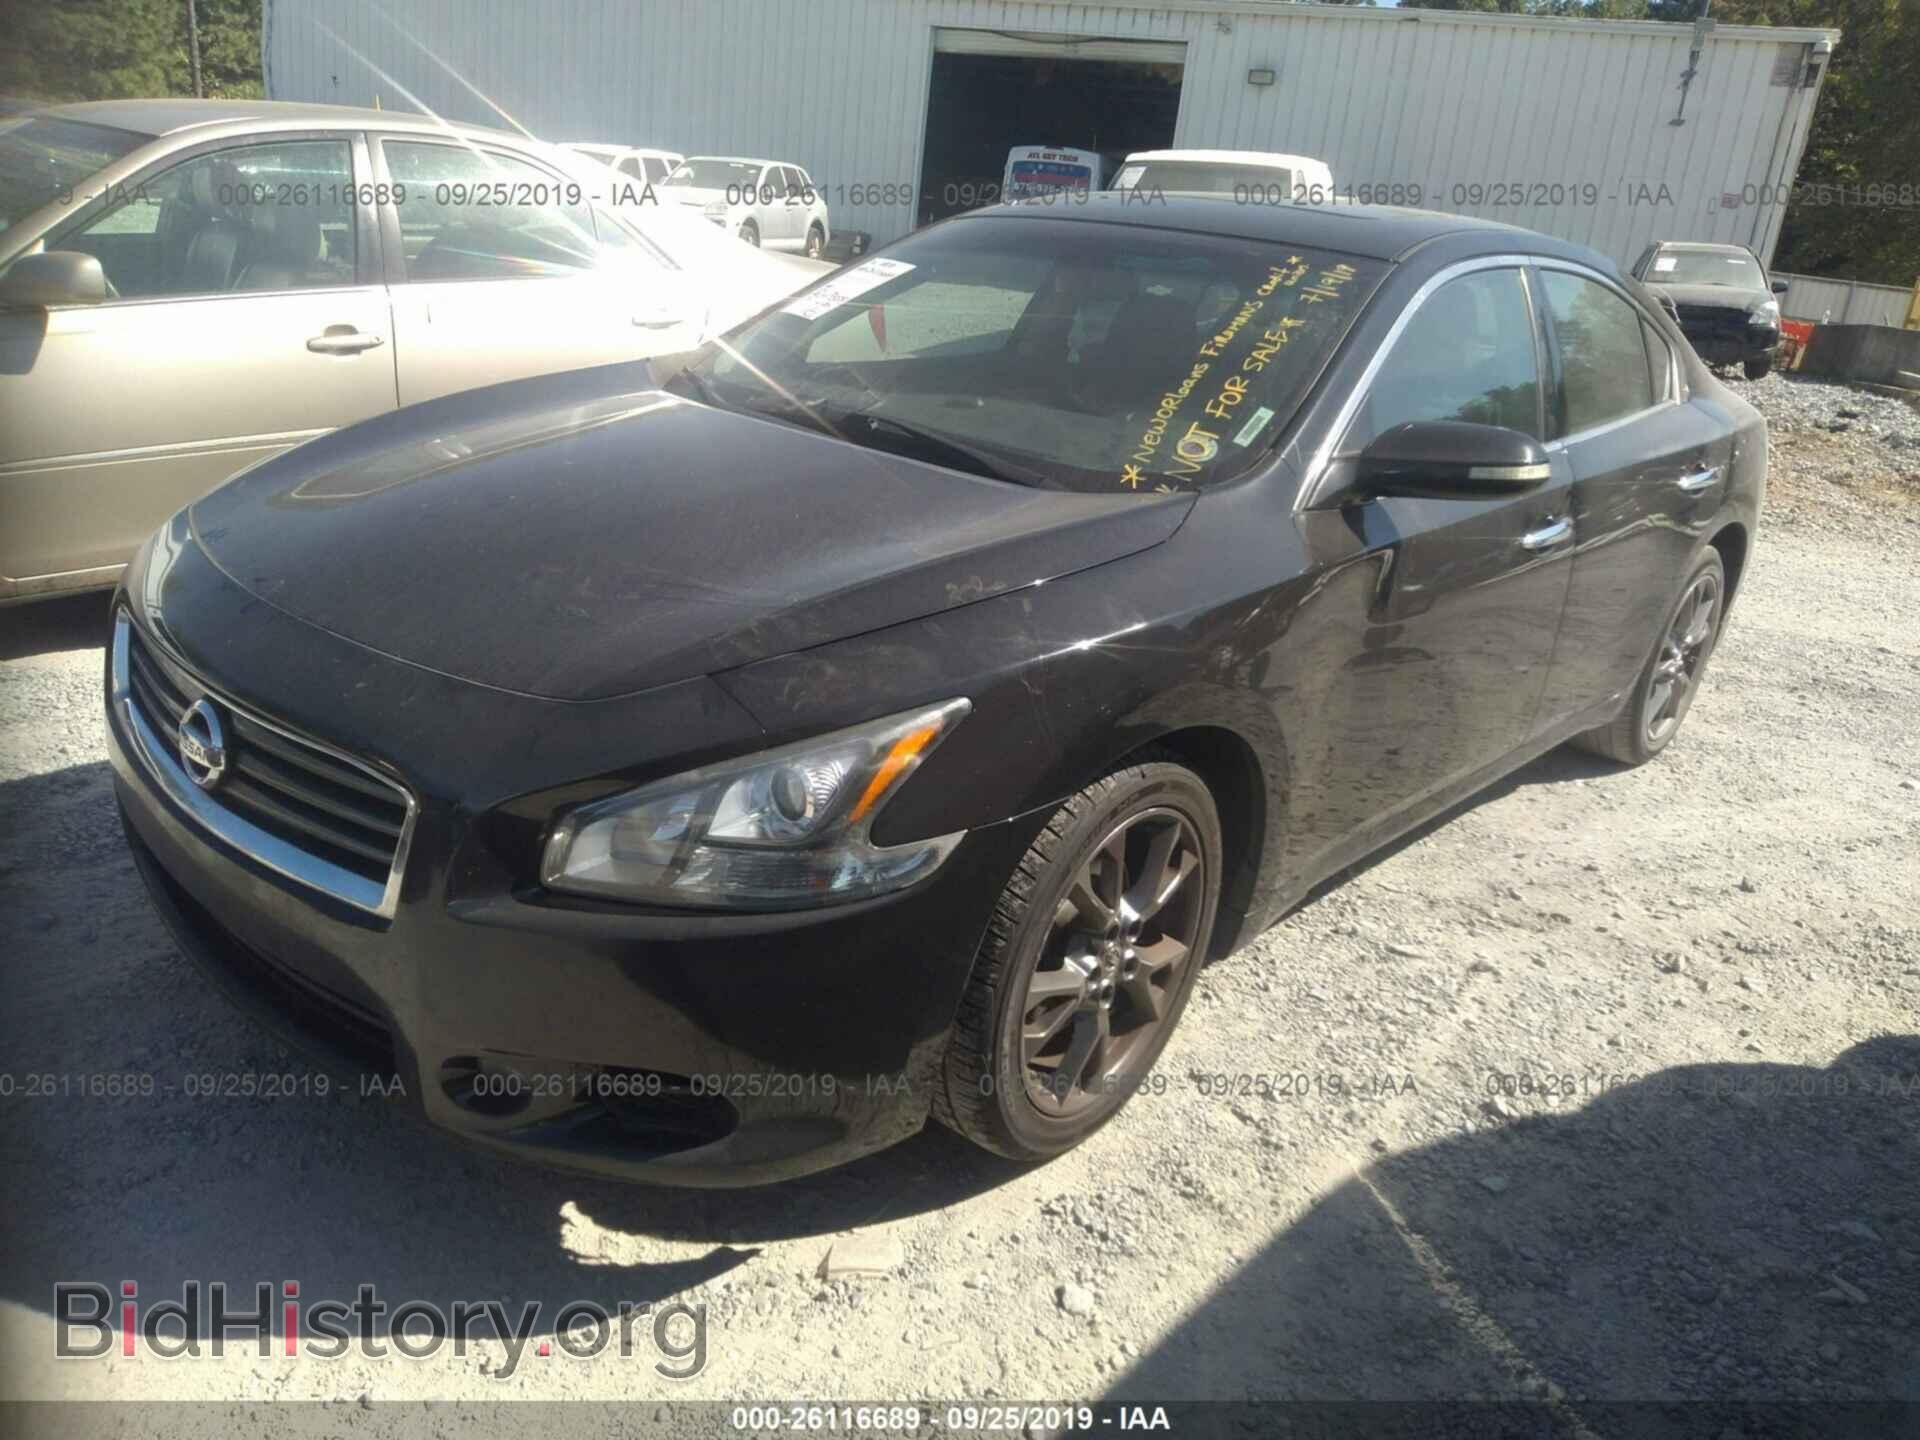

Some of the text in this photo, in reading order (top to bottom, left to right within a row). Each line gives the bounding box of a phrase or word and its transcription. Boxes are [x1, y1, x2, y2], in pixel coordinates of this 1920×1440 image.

[1164, 421, 1220, 482] NOT
[1205, 375, 1251, 420] FOR
[1242, 329, 1289, 372] SALE
